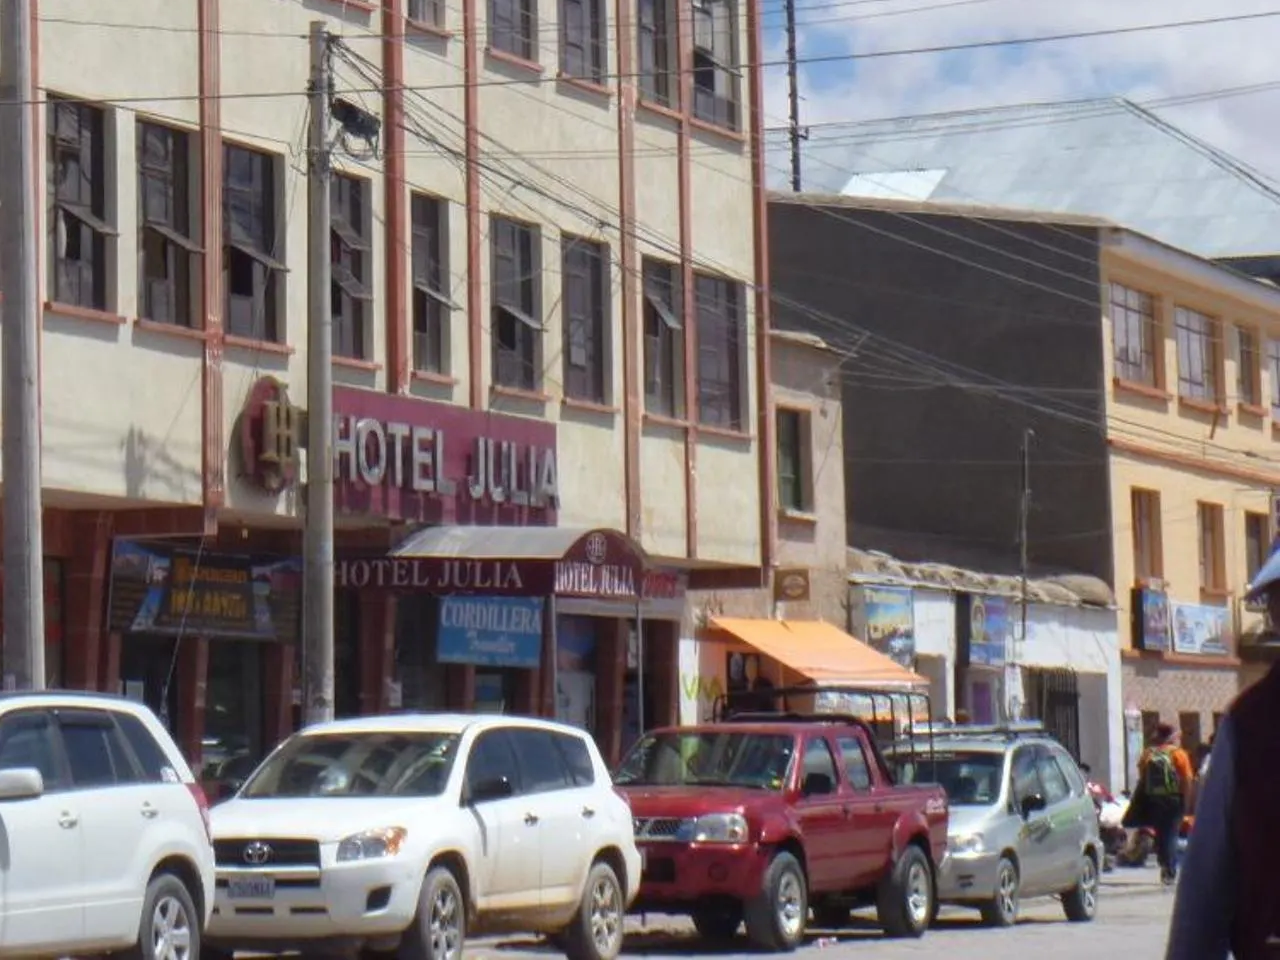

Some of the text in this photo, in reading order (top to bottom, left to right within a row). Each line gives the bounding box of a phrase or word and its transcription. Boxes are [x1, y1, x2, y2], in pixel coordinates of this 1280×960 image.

[332, 413, 456, 497] HOTEL
[468, 435, 560, 509] JULIA
[332, 558, 524, 590] HOTEL JULIA
[554, 560, 598, 593] HOTEL
[599, 563, 635, 596] JULIA
[440, 598, 543, 635] CORDILLERA
